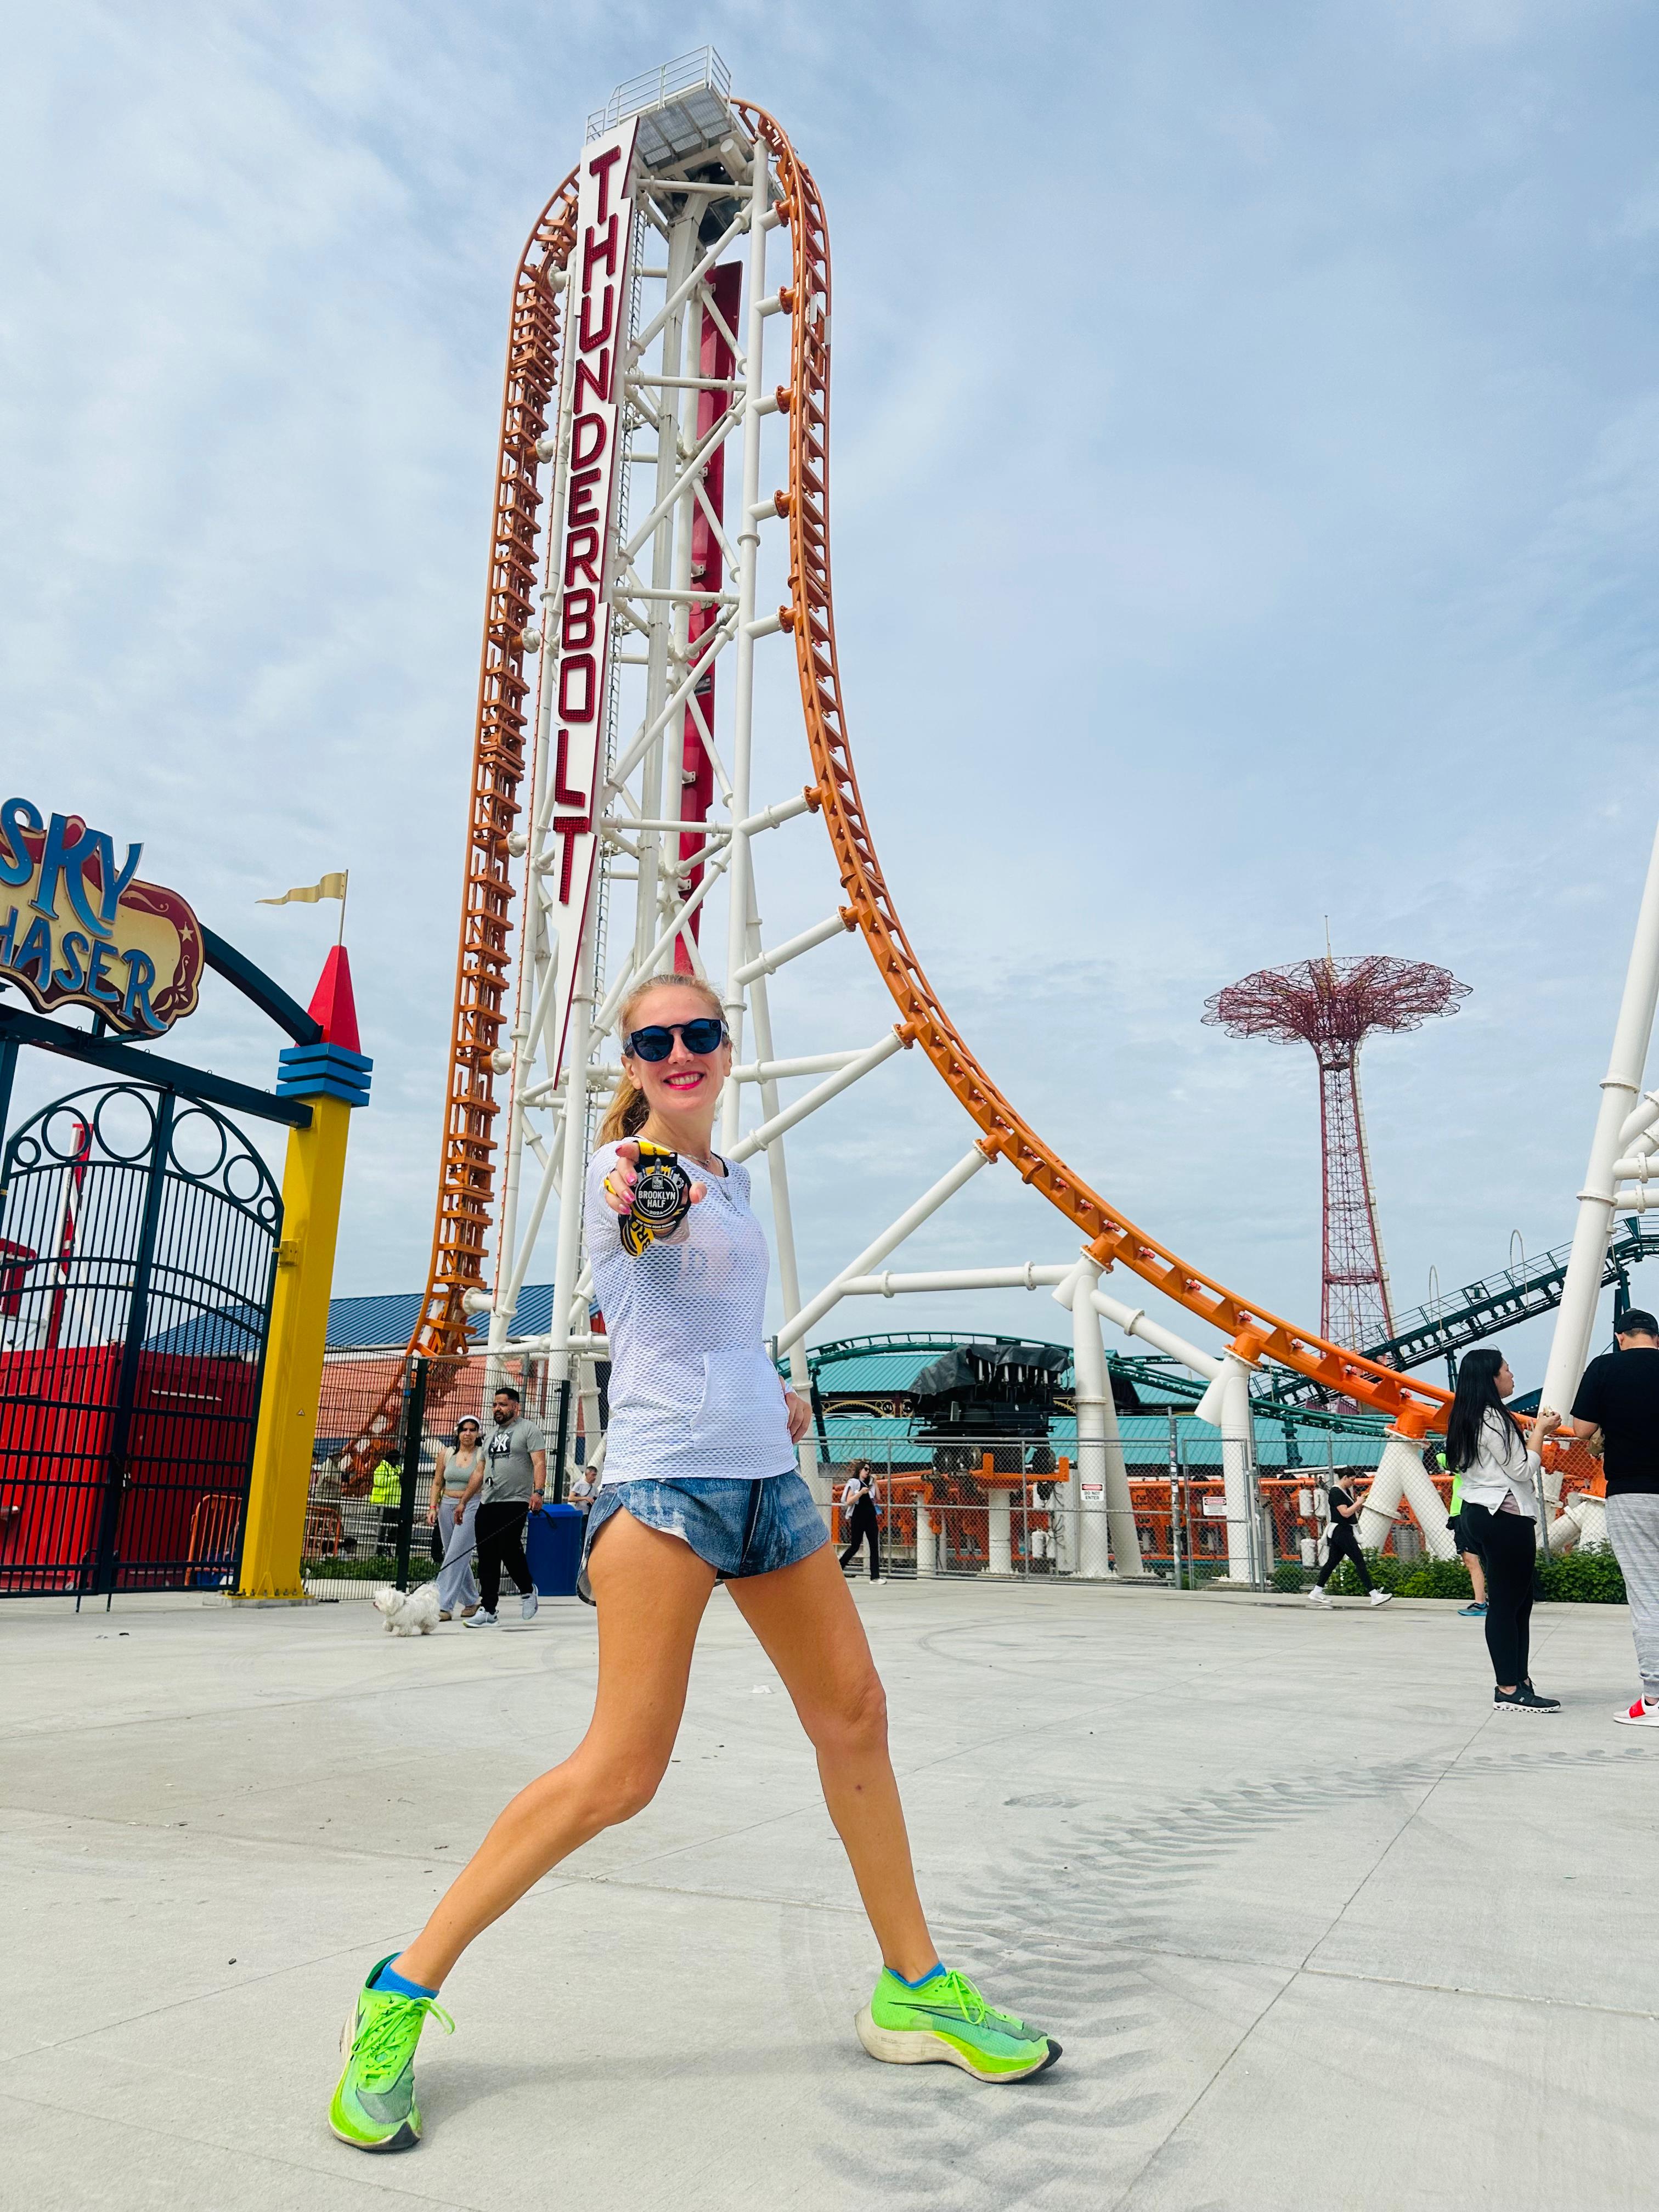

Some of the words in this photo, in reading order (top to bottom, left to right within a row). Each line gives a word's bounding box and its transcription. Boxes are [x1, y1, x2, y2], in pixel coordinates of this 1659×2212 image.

[553, 145, 621, 905] THUNDERBOLT
[0, 797, 144, 939] SKY
[638, 1190, 676, 1200] BROOKLYN
[647, 1199, 665, 1208] HALF
